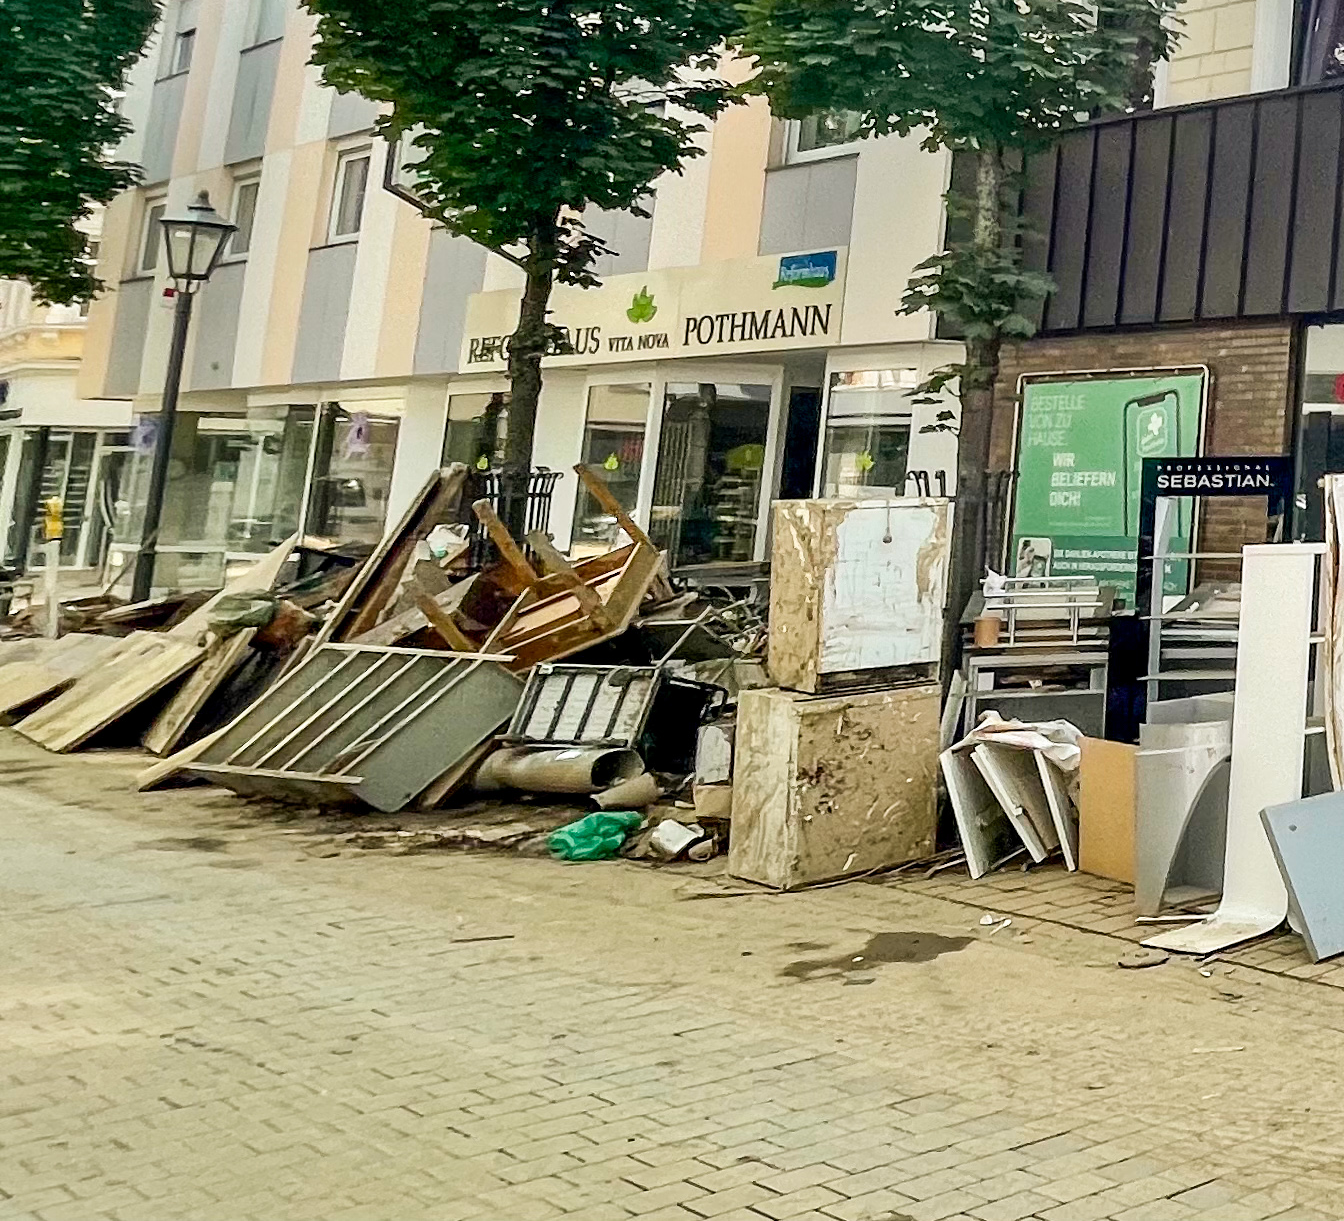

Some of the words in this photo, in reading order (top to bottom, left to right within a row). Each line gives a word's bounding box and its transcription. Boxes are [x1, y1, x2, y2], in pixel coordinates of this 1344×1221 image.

[608, 336, 635, 353] VITA
[637, 332, 670, 351] NOVA
[682, 303, 833, 346] POTHMANN
[1053, 452, 1076, 468] WIR
